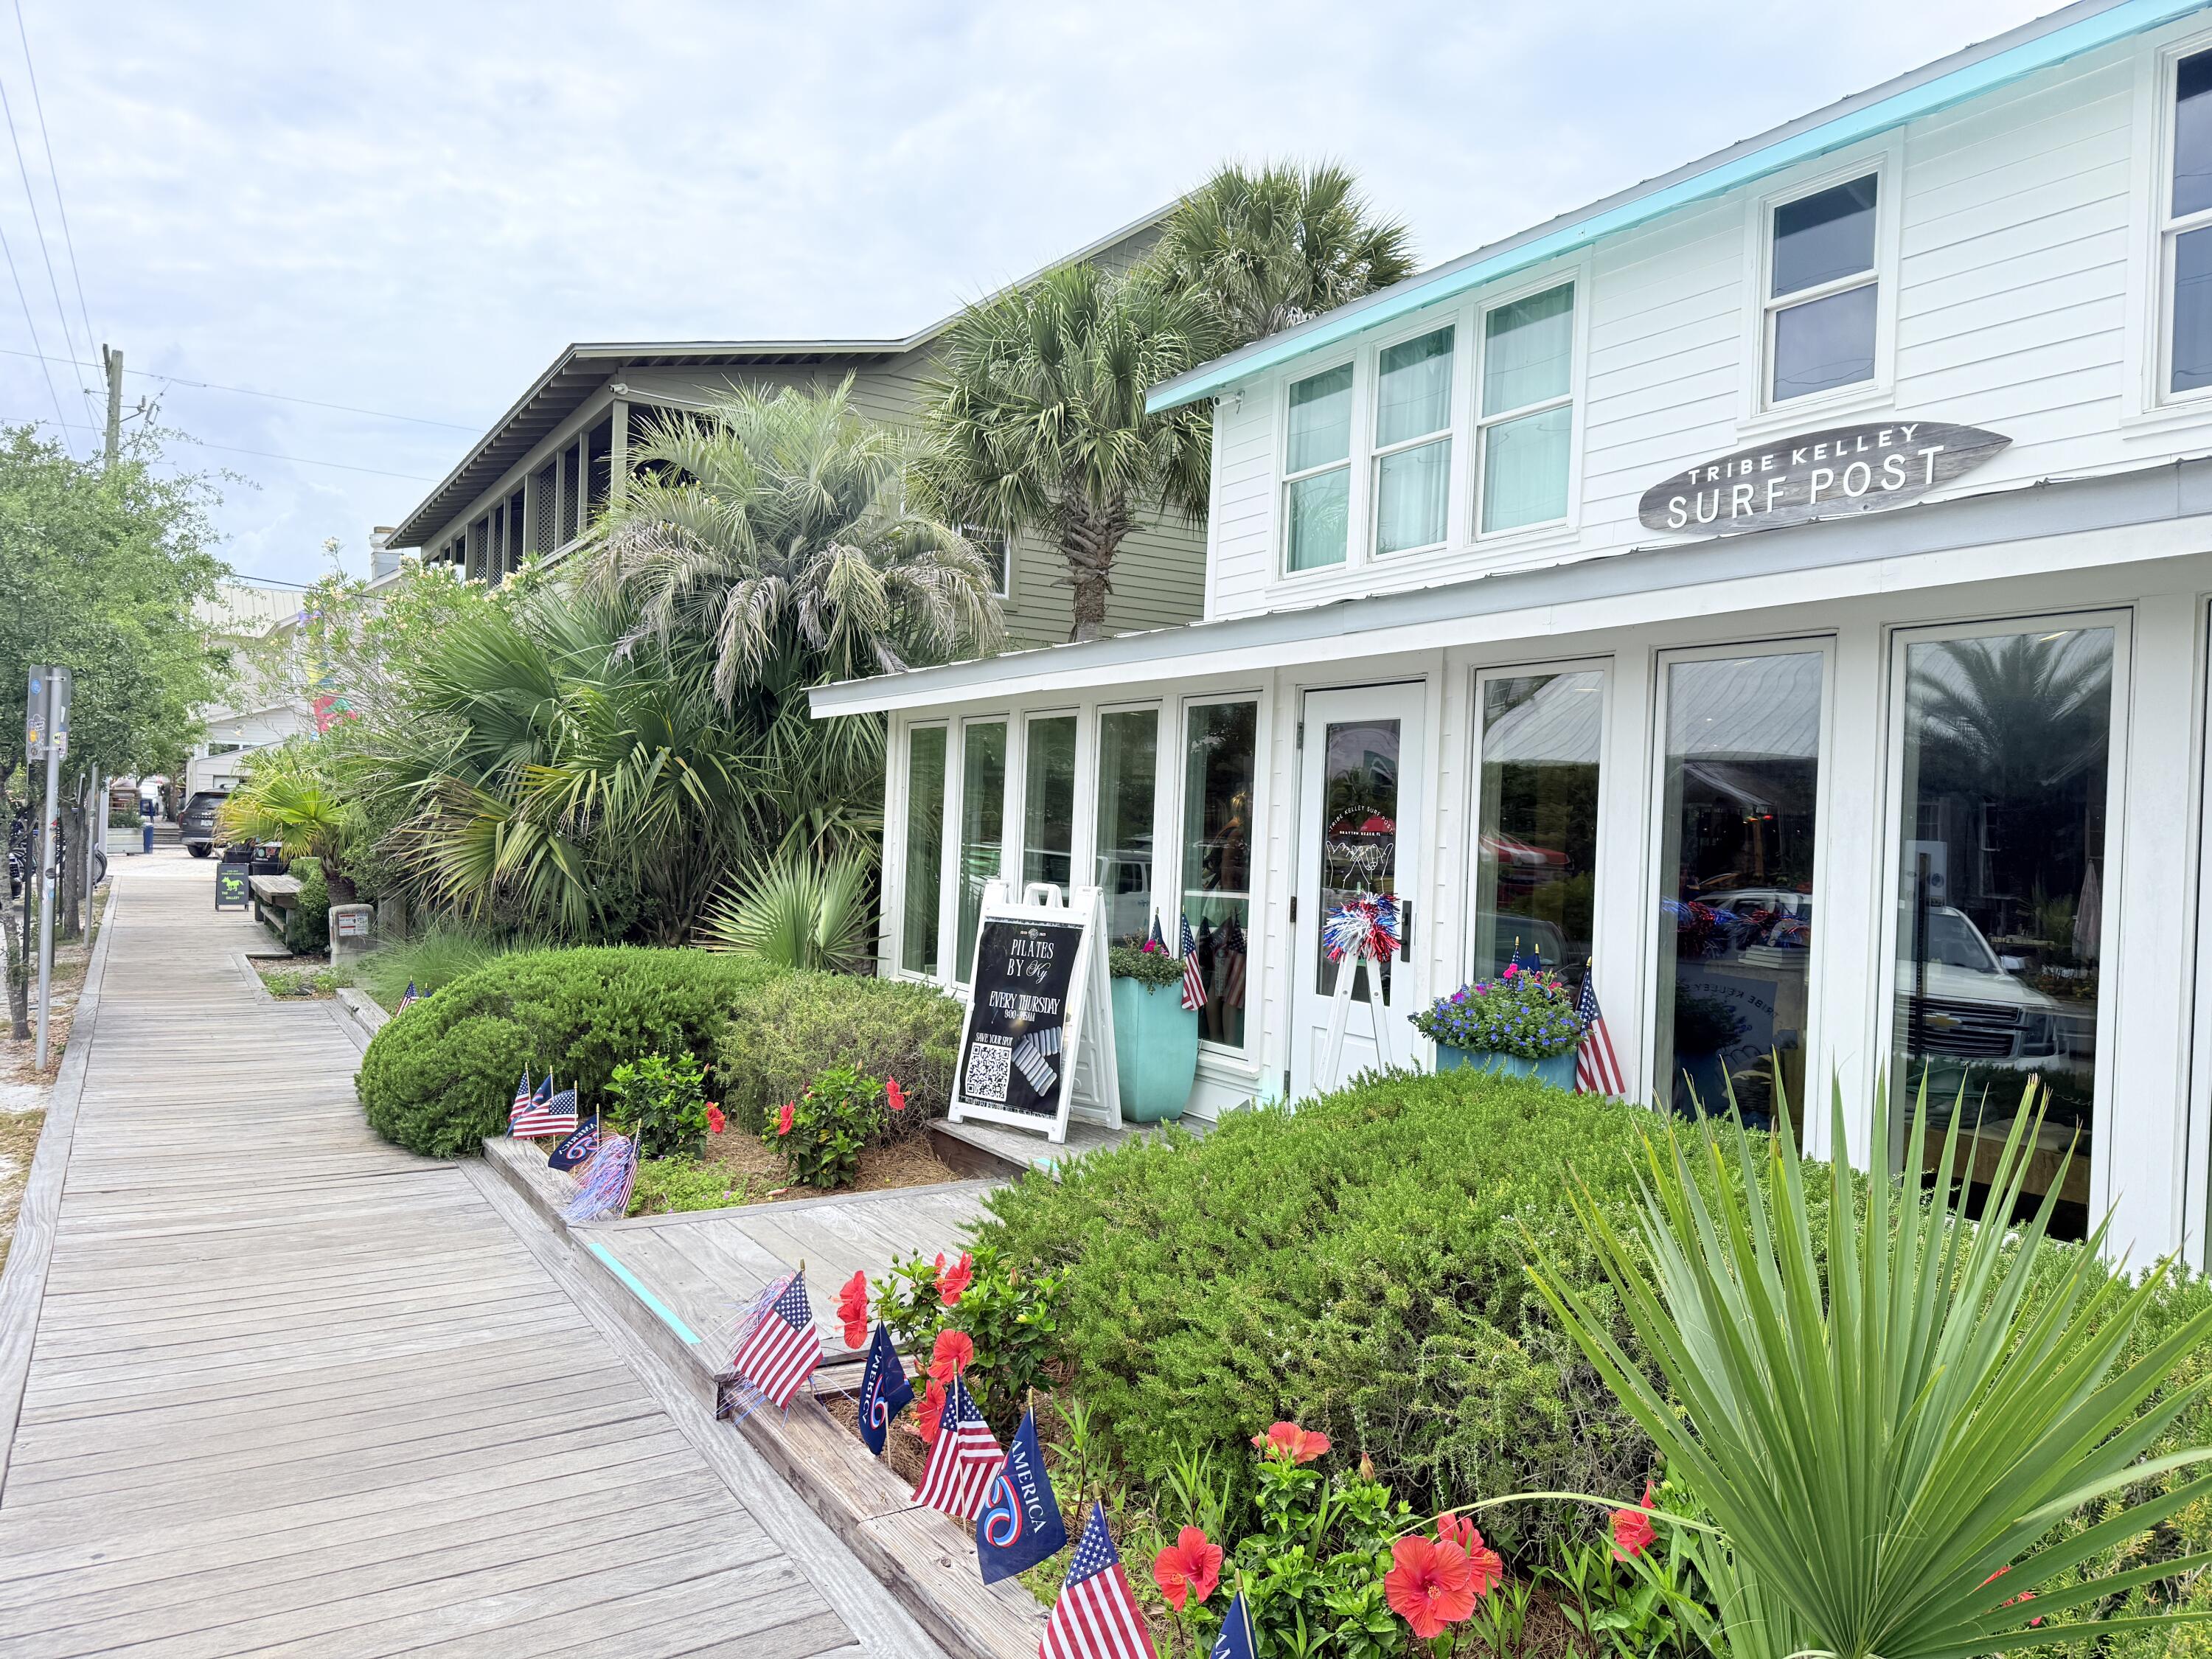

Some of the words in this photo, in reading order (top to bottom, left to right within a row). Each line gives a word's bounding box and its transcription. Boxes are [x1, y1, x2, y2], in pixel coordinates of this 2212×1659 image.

[1688, 454, 1775, 485] TRIBE
[1792, 423, 1919, 465] KELLEY
[1666, 476, 1787, 529] SURF
[1810, 445, 1944, 504] POST
[1344, 805, 1365, 815] KELLEY
[1366, 806, 1381, 816] SURF
[1011, 939, 1054, 959] PILATES
[1006, 958, 1024, 977] BY
[1026, 959, 1051, 984] Ky
[989, 990, 1018, 1009] EVERY
[1018, 994, 1060, 1015] THURSDAY
[975, 1032, 989, 1043] SAVE
[990, 1034, 1002, 1046] YOUR
[1003, 1036, 1013, 1046] SPOT
[1012, 1439, 1047, 1534] AMERICA
